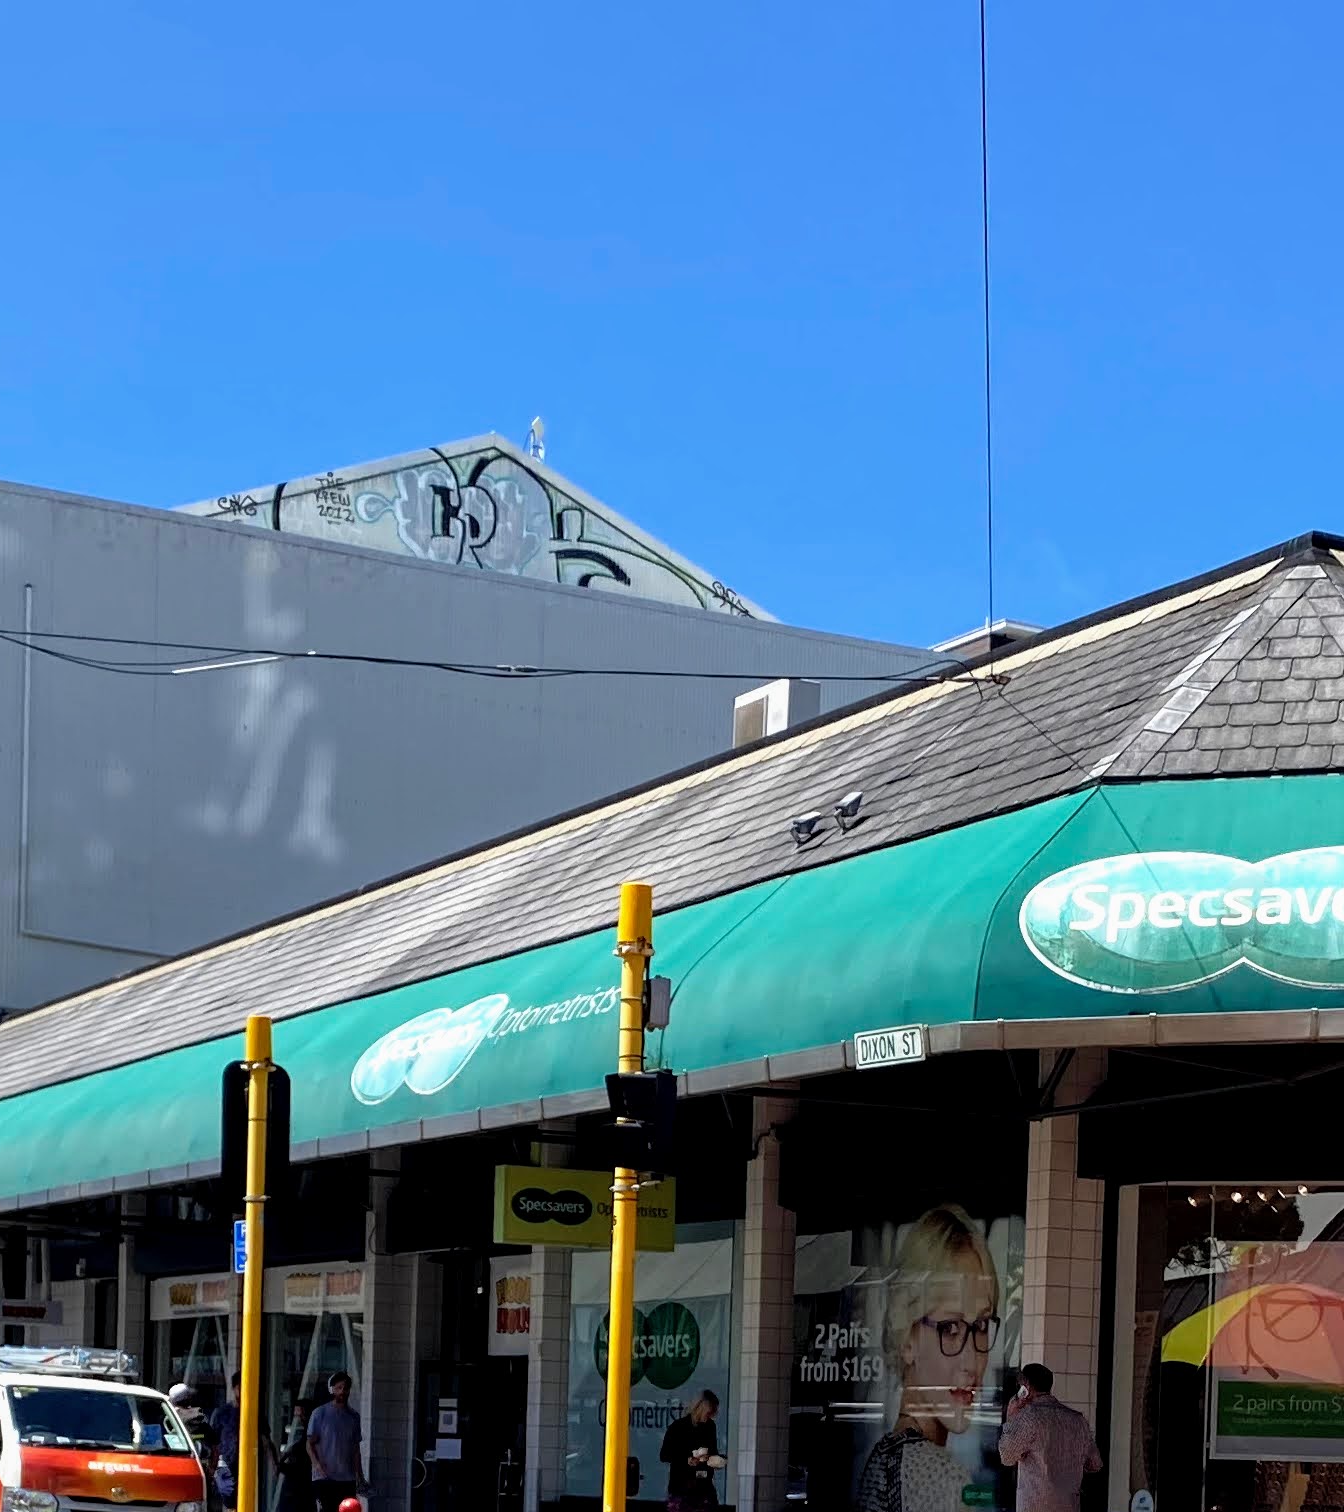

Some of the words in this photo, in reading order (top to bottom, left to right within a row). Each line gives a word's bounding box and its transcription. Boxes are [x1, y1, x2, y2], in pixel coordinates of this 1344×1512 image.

[860, 1034, 896, 1061] DIXON
[902, 1032, 916, 1055] ST
[519, 1197, 585, 1214] Specsavers
[814, 1323, 826, 1349] 2
[799, 1355, 840, 1382] from
[842, 1355, 884, 1382] $169
[1232, 1394, 1244, 1411] 2
[1247, 1395, 1286, 1415] pairs
[1289, 1394, 1328, 1412] from
